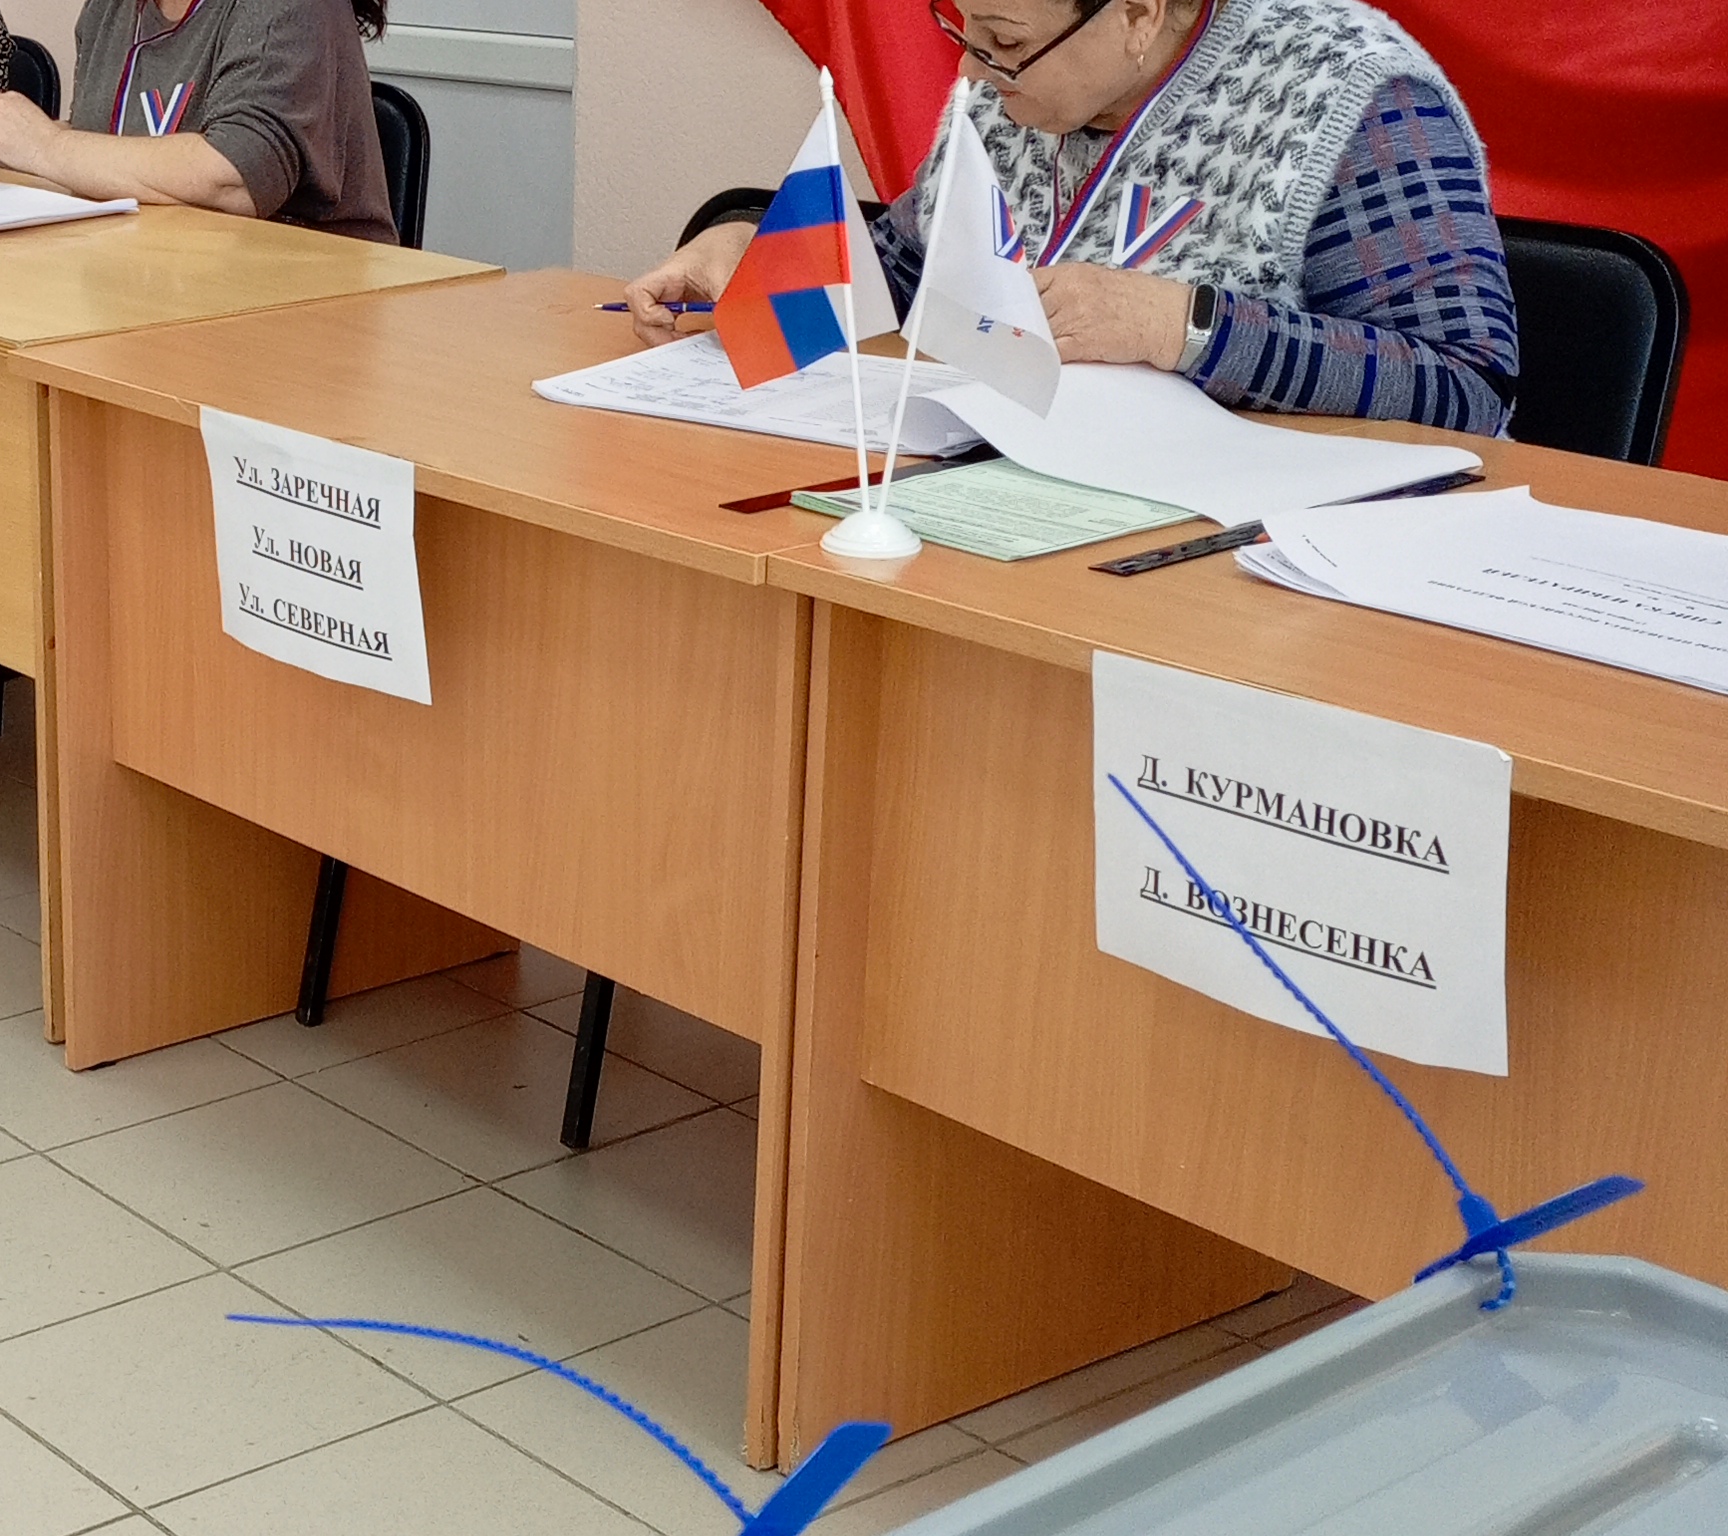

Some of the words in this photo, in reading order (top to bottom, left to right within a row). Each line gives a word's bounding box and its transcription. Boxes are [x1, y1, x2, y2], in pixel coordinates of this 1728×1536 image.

[233, 456, 263, 486] Ул.
[270, 467, 382, 523] ЗАРЕЧНАЯ
[252, 525, 280, 557] Ул.
[289, 538, 364, 585] НОВАЯ
[239, 582, 264, 614] Ул.
[273, 597, 391, 655] СЕВЕРНАЯ
[1137, 754, 1168, 790] Д.
[1184, 766, 1450, 867] КУРМАНОВКА
[1140, 866, 1169, 901] Д.
[1184, 879, 1437, 983] ВОЗНЕСЕНКА
